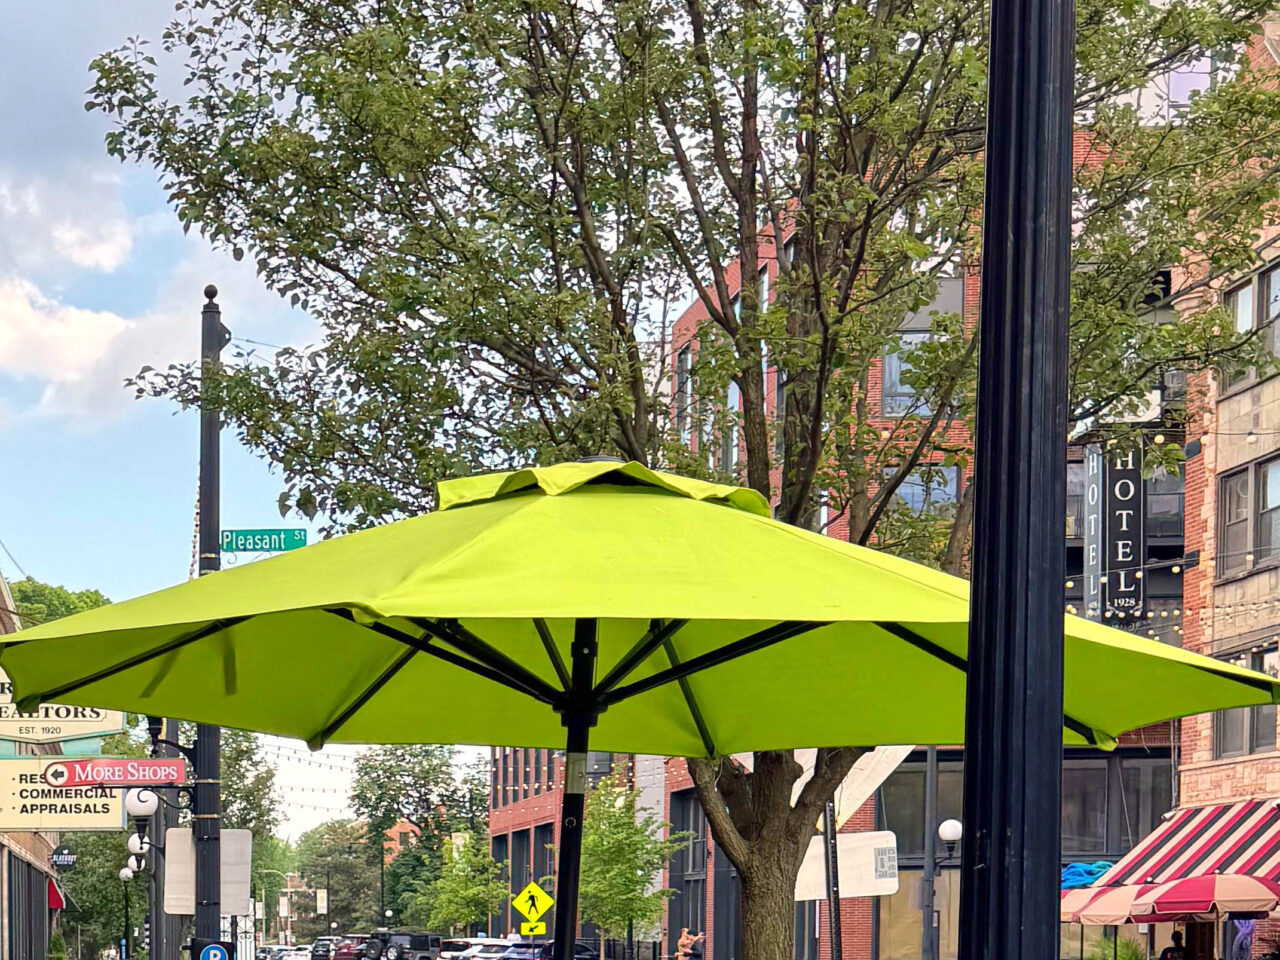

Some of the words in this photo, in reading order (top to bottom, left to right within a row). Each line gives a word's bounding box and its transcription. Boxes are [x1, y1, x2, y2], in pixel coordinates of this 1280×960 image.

[1088, 453, 1098, 595] HOTEL
[1114, 449, 1136, 592] HOTEL
[223, 531, 285, 549] Pleasant
[294, 530, 305, 540] St
[1114, 598, 1135, 607] 1928
[19, 727, 38, 735] EST.
[42, 727, 61, 735] 1920
[19, 773, 47, 784] RES
[19, 788, 117, 799] COMMERCIAL
[20, 803, 111, 814] APPRAISALS
